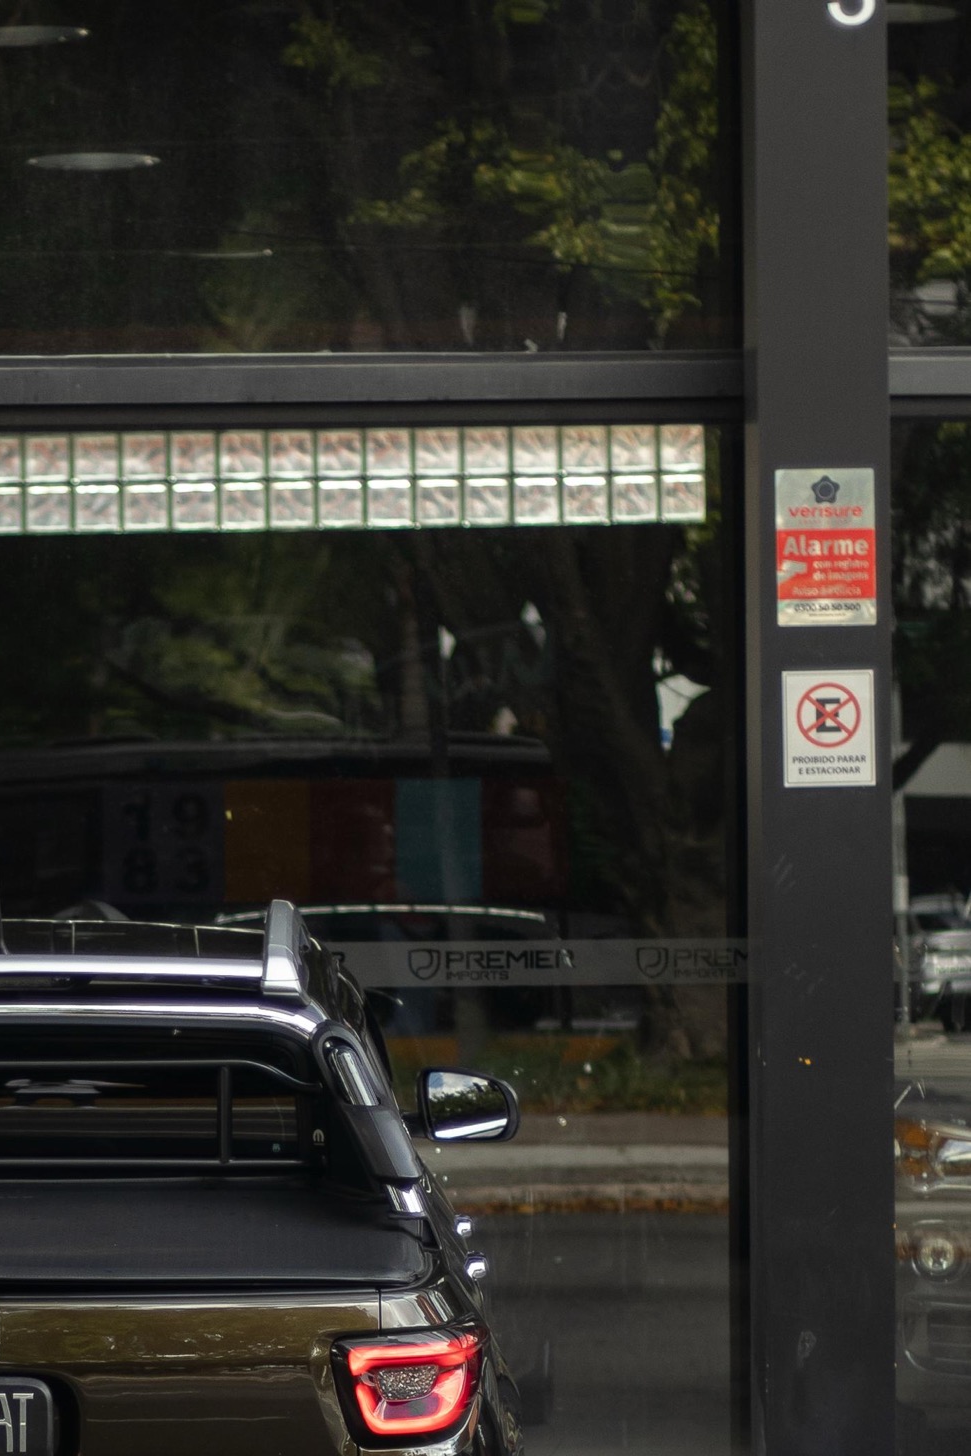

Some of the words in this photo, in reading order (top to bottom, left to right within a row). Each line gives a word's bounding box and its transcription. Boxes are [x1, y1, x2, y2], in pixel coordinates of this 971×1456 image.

[788, 504, 863, 518] verisure
[783, 535, 869, 556] Alarme
[792, 755, 835, 764] PROIBIDO
[837, 754, 867, 763] PARAR
[798, 766, 804, 775] E
[805, 765, 861, 775] ESTACIONAR
[445, 949, 576, 970] PREMIER
[445, 969, 510, 981] IMPORTS
